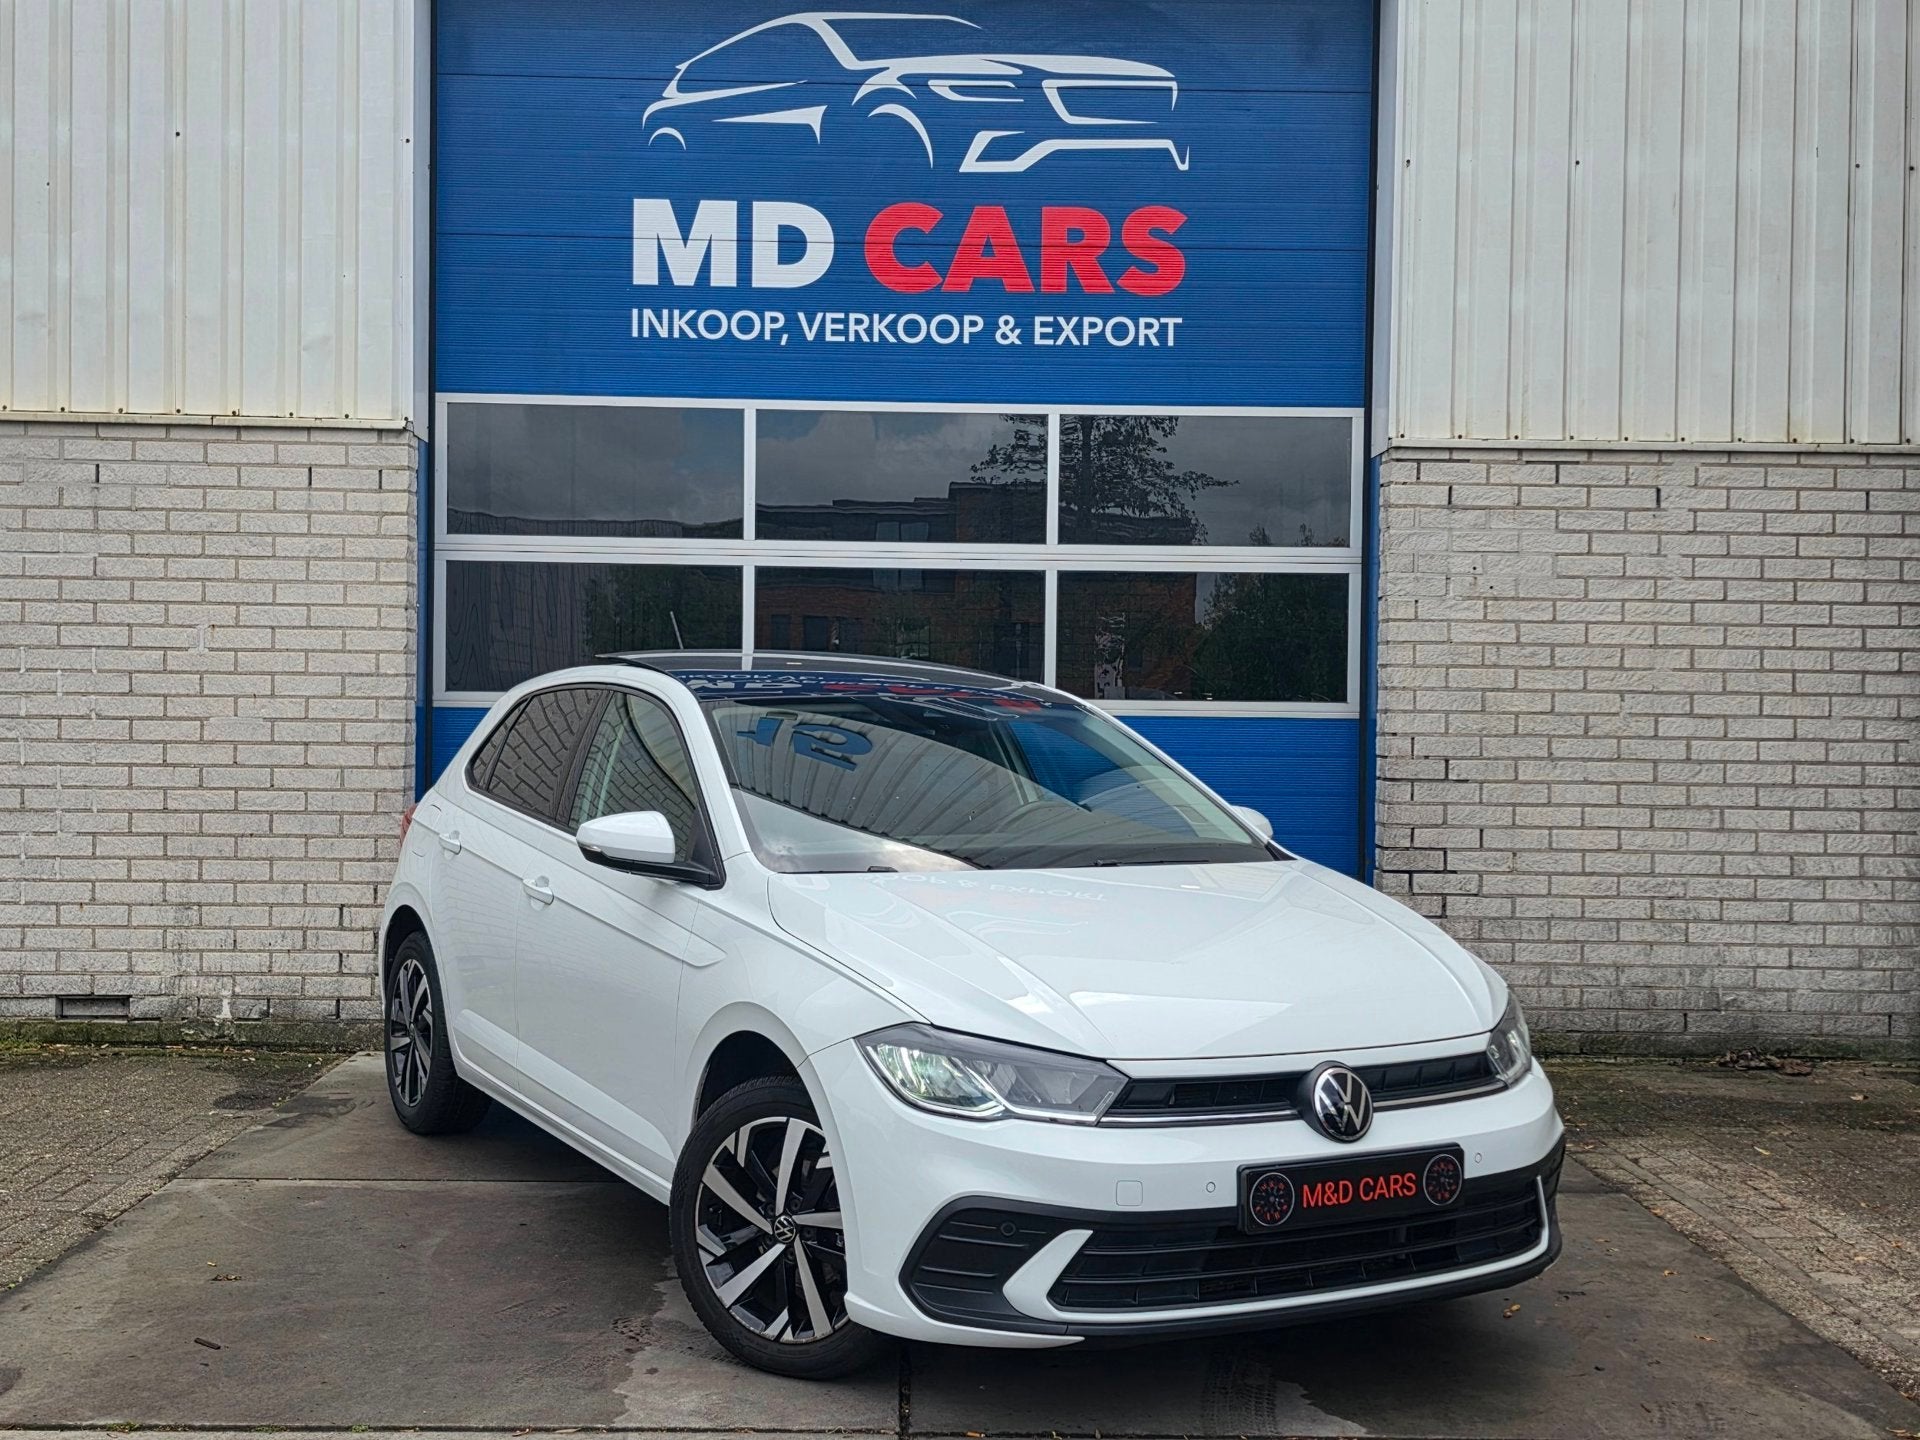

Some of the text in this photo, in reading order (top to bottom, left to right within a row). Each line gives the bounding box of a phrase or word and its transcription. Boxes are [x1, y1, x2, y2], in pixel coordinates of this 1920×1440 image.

[632, 198, 1188, 297] MD CARS
[631, 308, 1183, 347] INKOOP, VERKOOP & EXPORT
[1302, 1178, 1353, 1209] M&D
[1358, 1172, 1417, 1202] CARS
